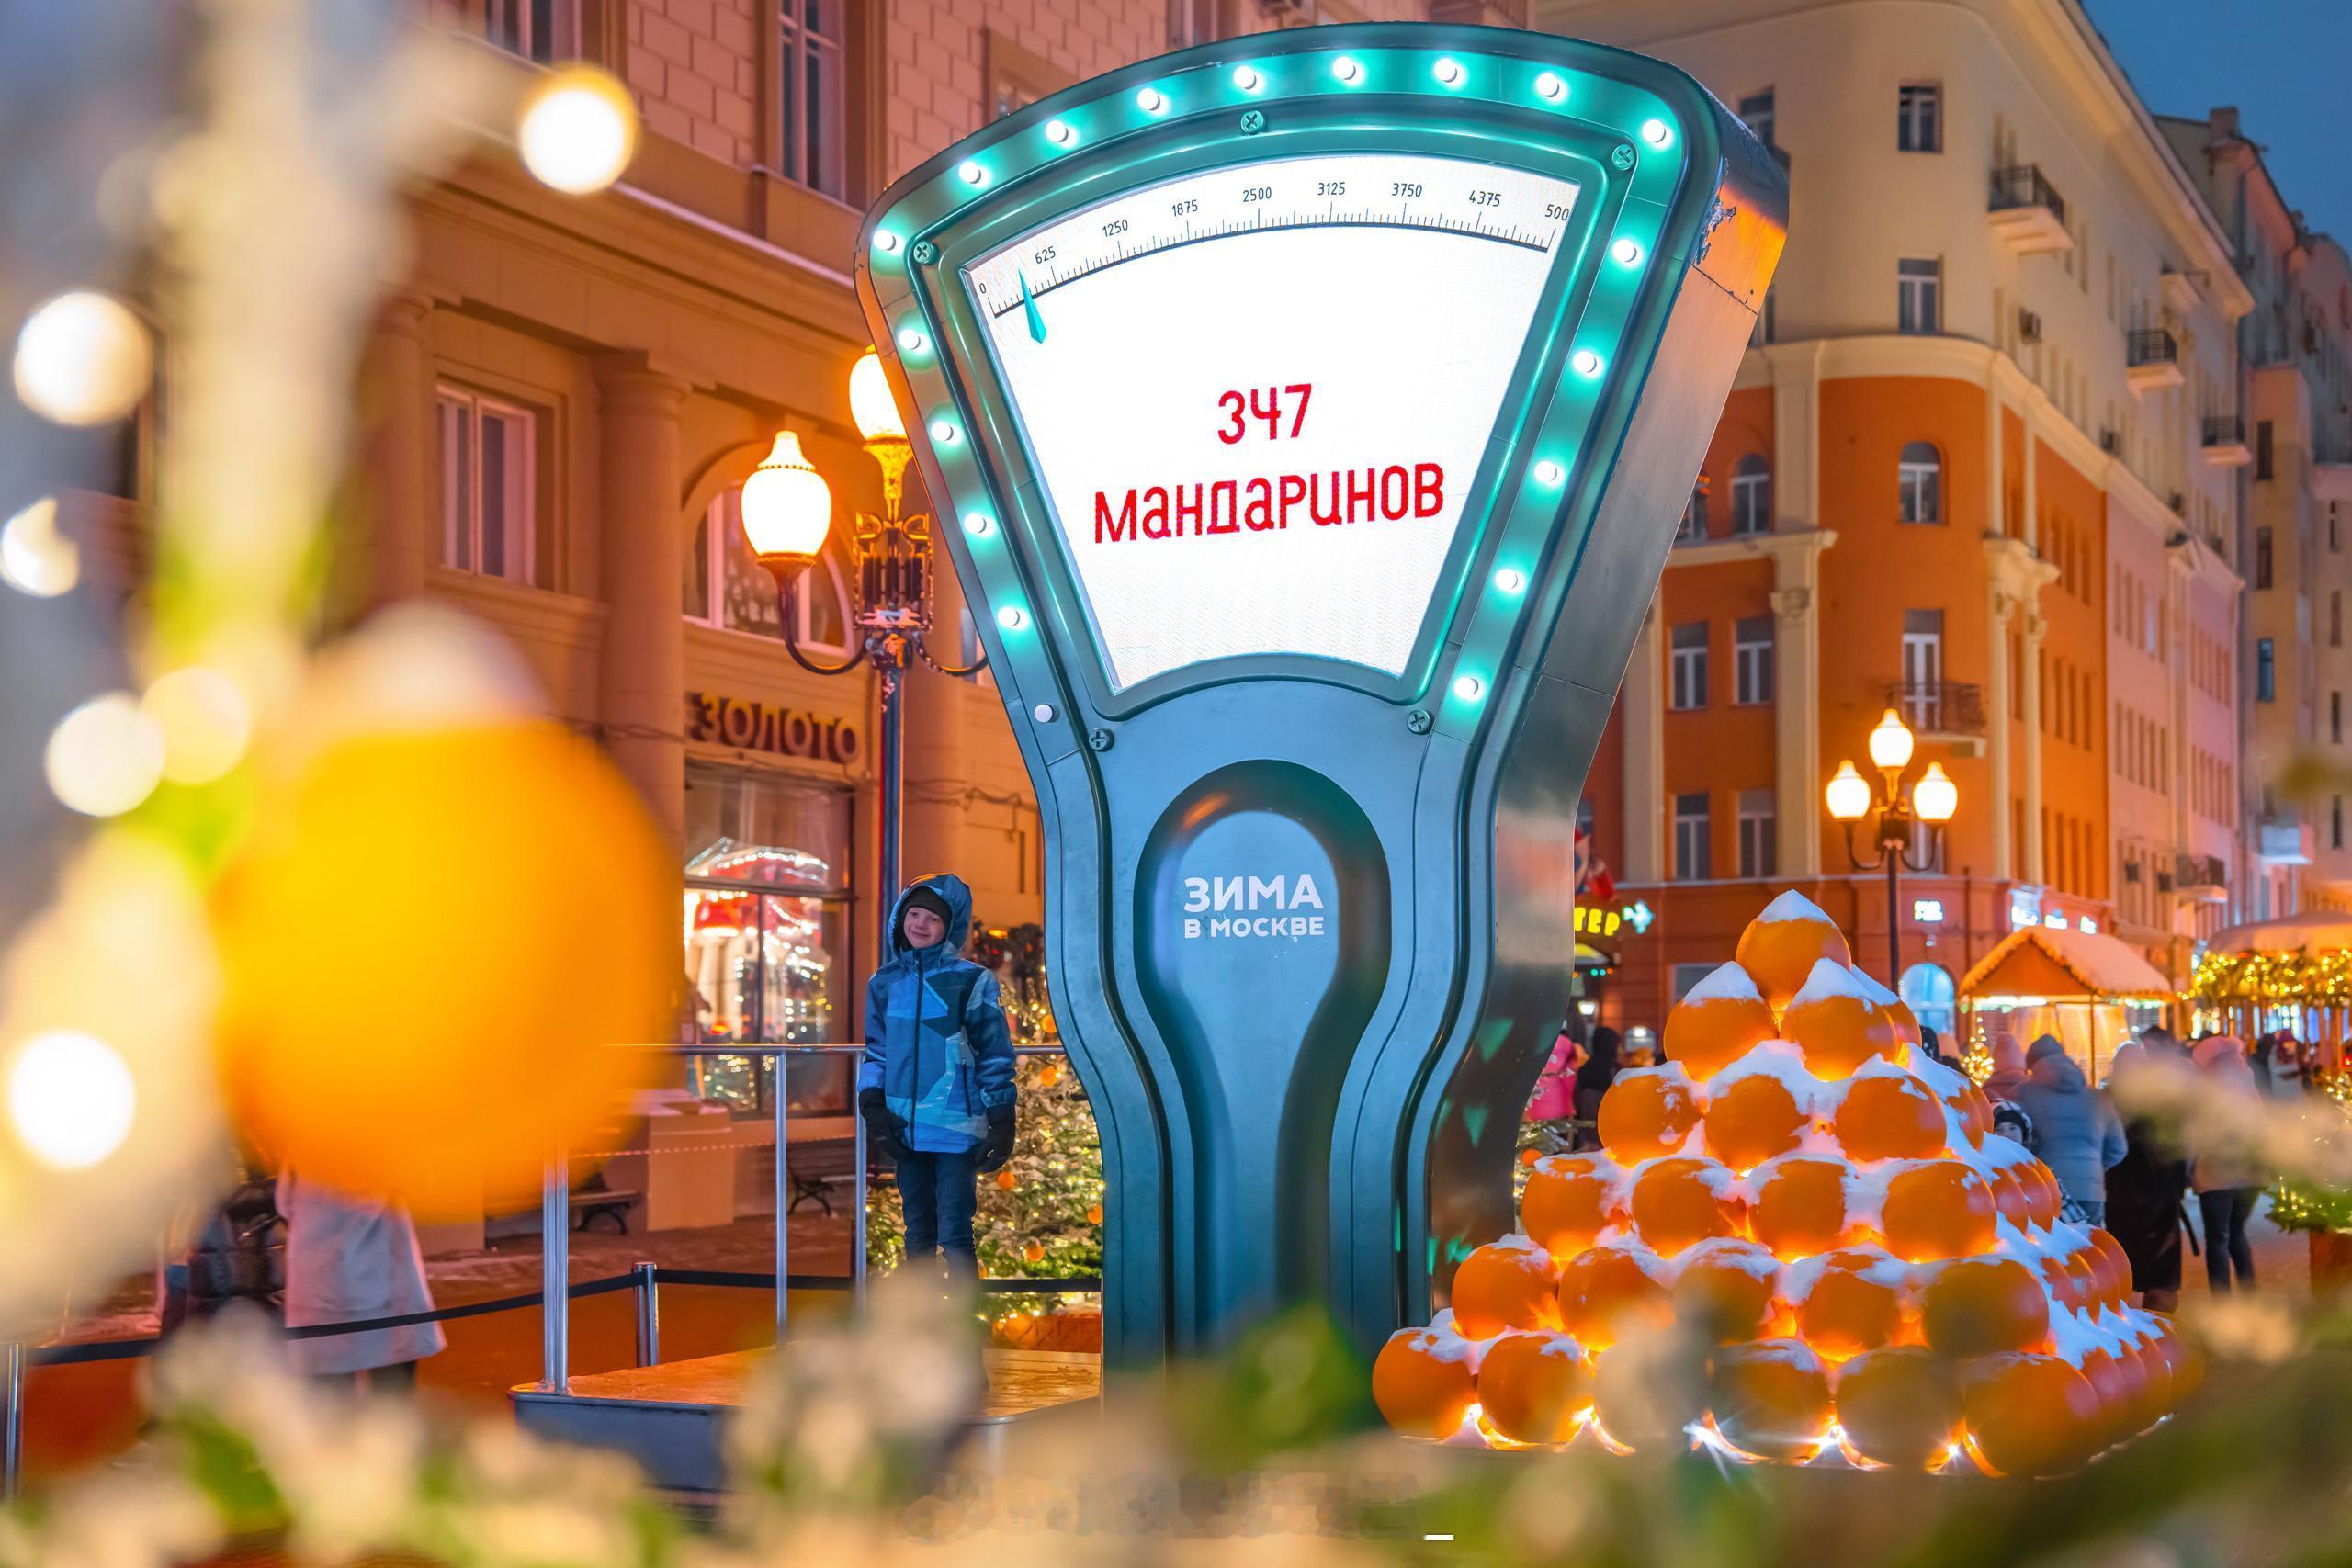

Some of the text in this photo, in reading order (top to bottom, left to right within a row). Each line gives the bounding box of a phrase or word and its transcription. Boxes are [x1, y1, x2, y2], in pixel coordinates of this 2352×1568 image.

[978, 282, 988, 294] 0
[1035, 245, 1057, 265] 625
[1102, 219, 1129, 238] 1250
[1171, 199, 1199, 217] 1875
[1242, 186, 1272, 203] 2500
[1317, 182, 1346, 196] 3125
[1391, 183, 1423, 197] 3750
[1468, 189, 1502, 207] 4375
[1217, 382, 1313, 445] 347
[694, 692, 860, 764] ЗОЛОТО
[1183, 874, 1324, 913] ЗИМА
[1184, 916, 1325, 938] В МОСКВЕ
